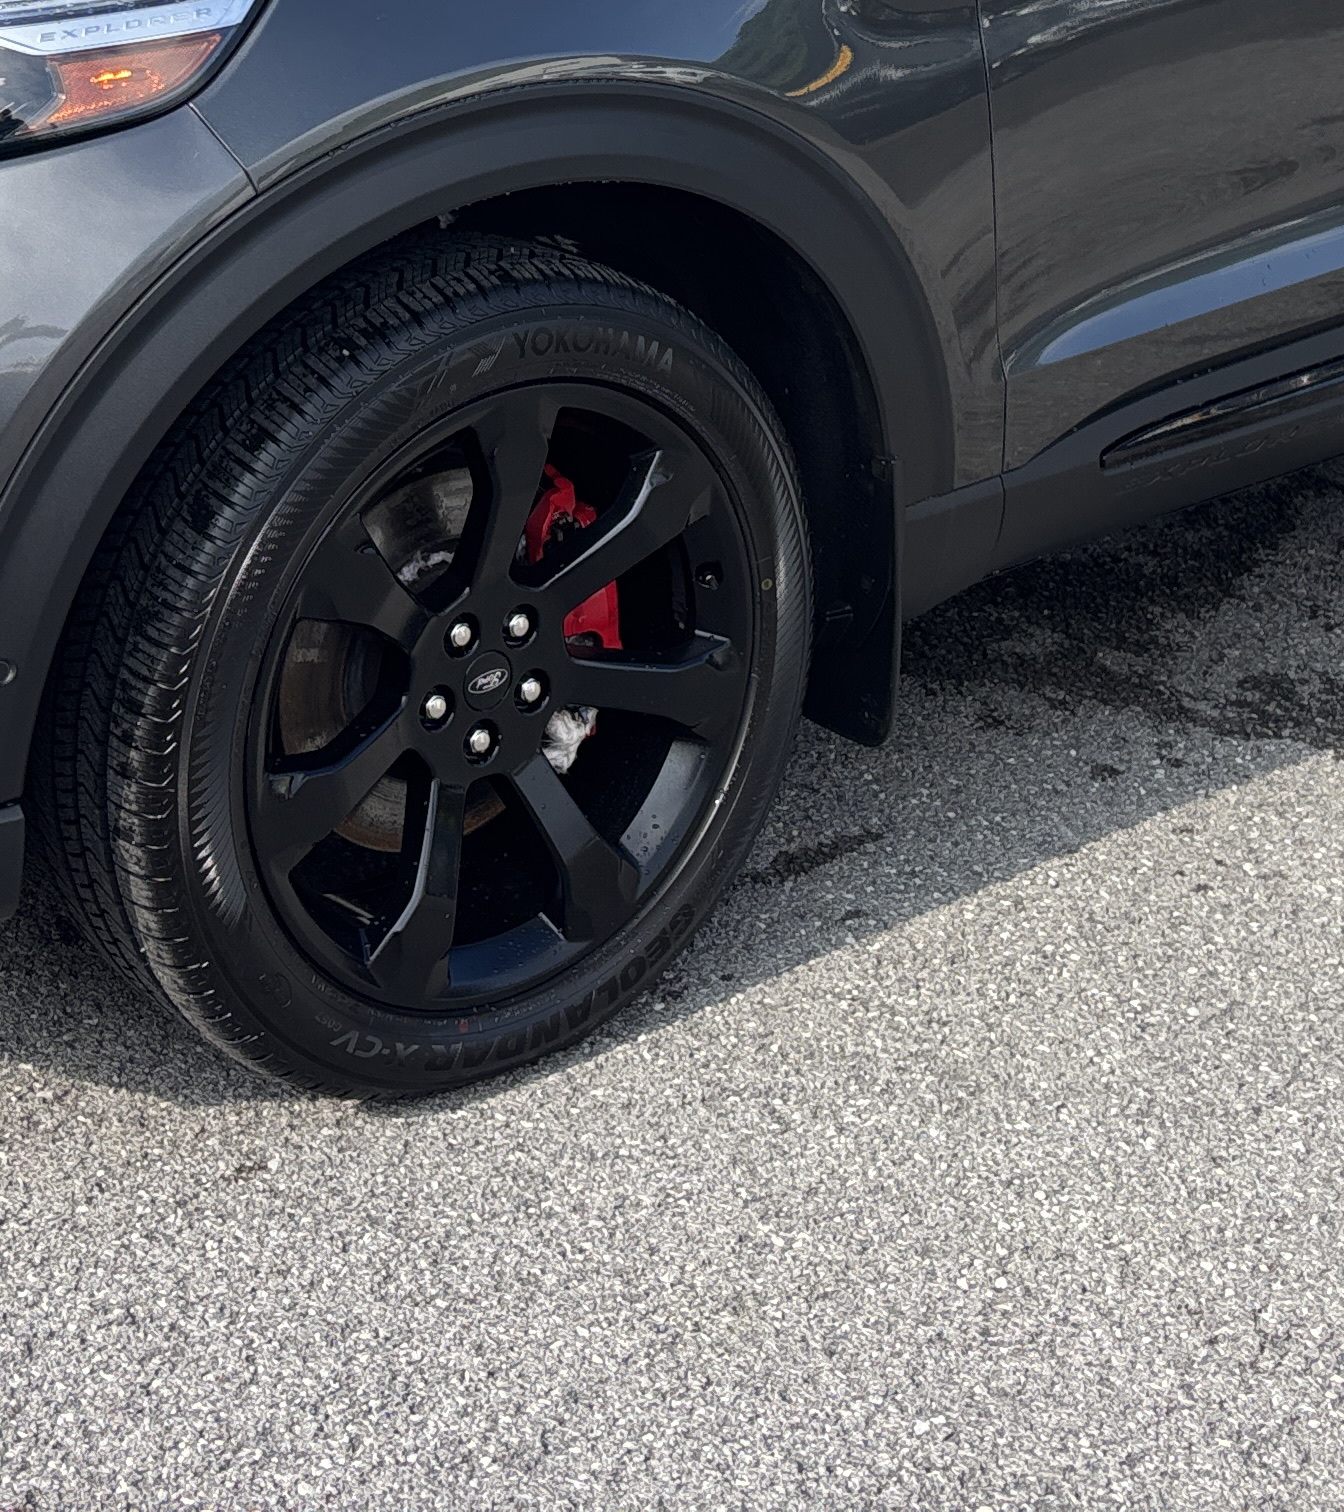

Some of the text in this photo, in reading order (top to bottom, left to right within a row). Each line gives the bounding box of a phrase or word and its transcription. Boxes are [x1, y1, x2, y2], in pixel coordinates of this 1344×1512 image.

[37, 6, 213, 43] EXPLORER
[512, 326, 674, 372] YOKOHAMA
[423, 902, 696, 1075] GEOLANDAR
